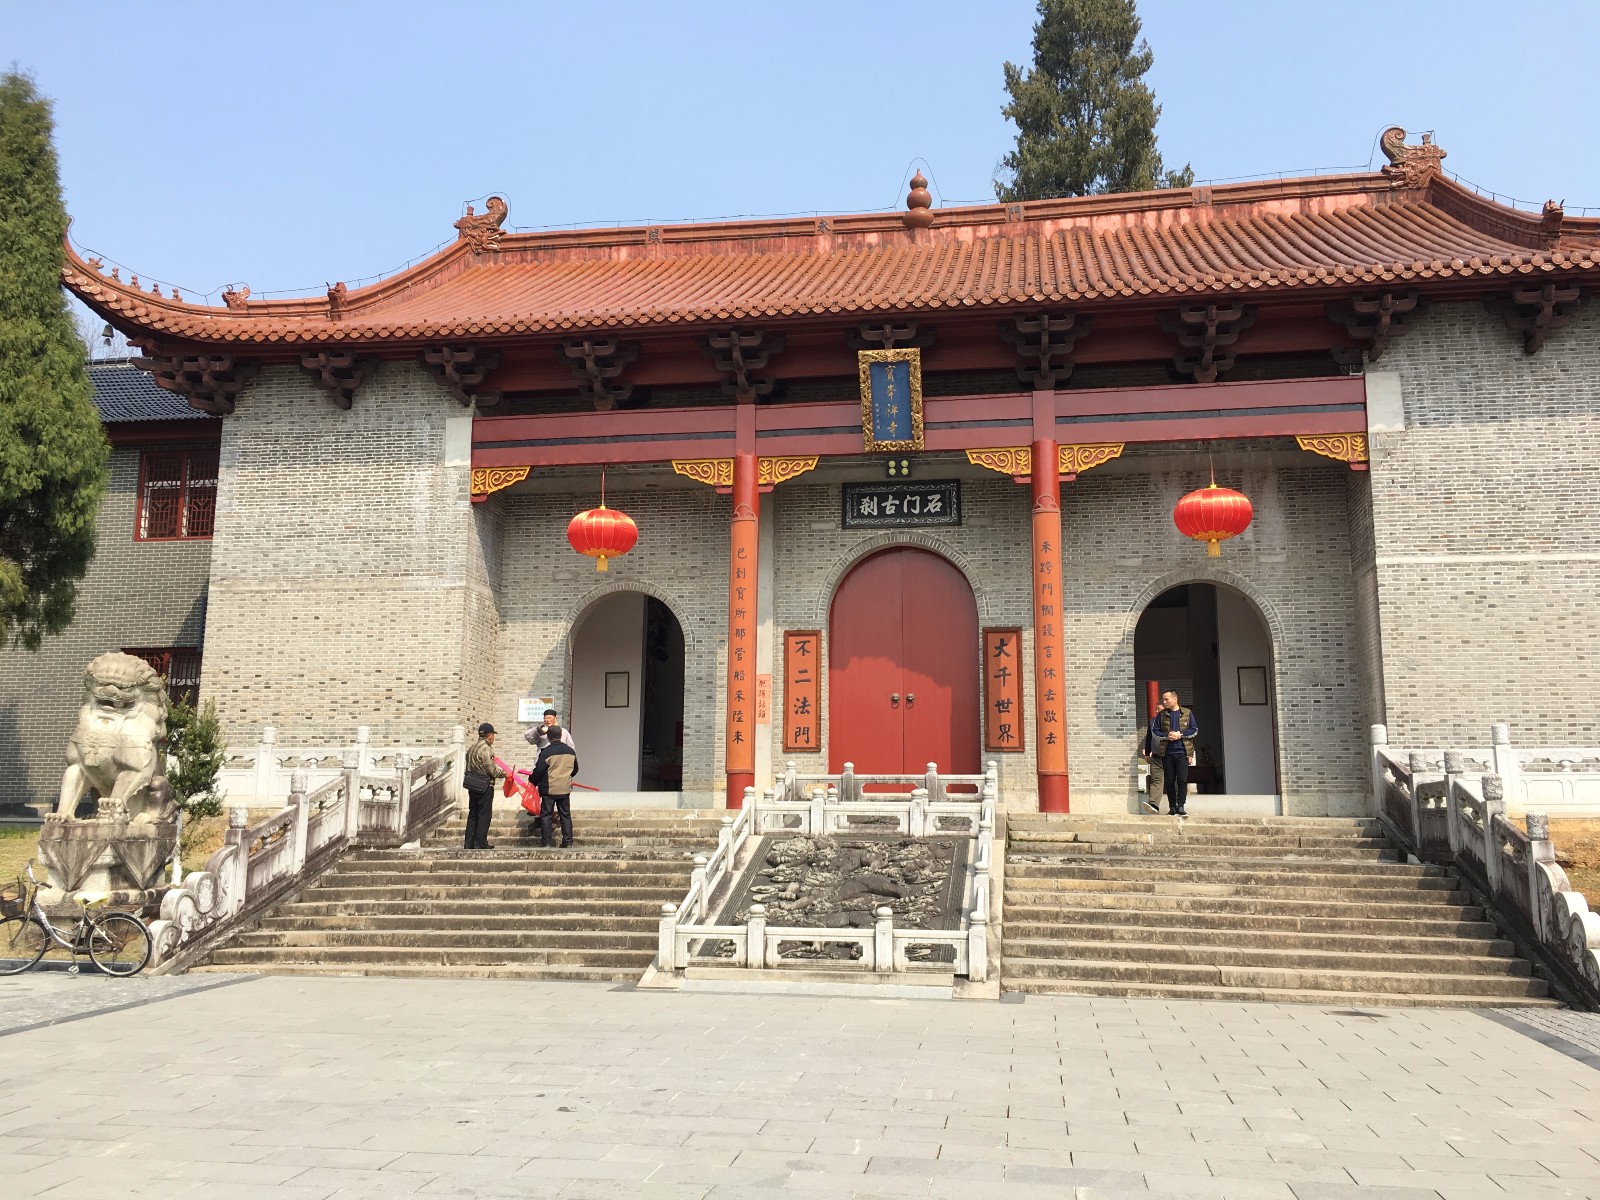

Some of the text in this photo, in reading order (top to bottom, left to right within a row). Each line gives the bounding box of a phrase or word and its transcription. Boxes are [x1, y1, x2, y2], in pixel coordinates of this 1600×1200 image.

[859, 494, 943, 516] 石门古刹
[794, 640, 812, 744] 不二法門
[993, 638, 1015, 743] 大千世界
